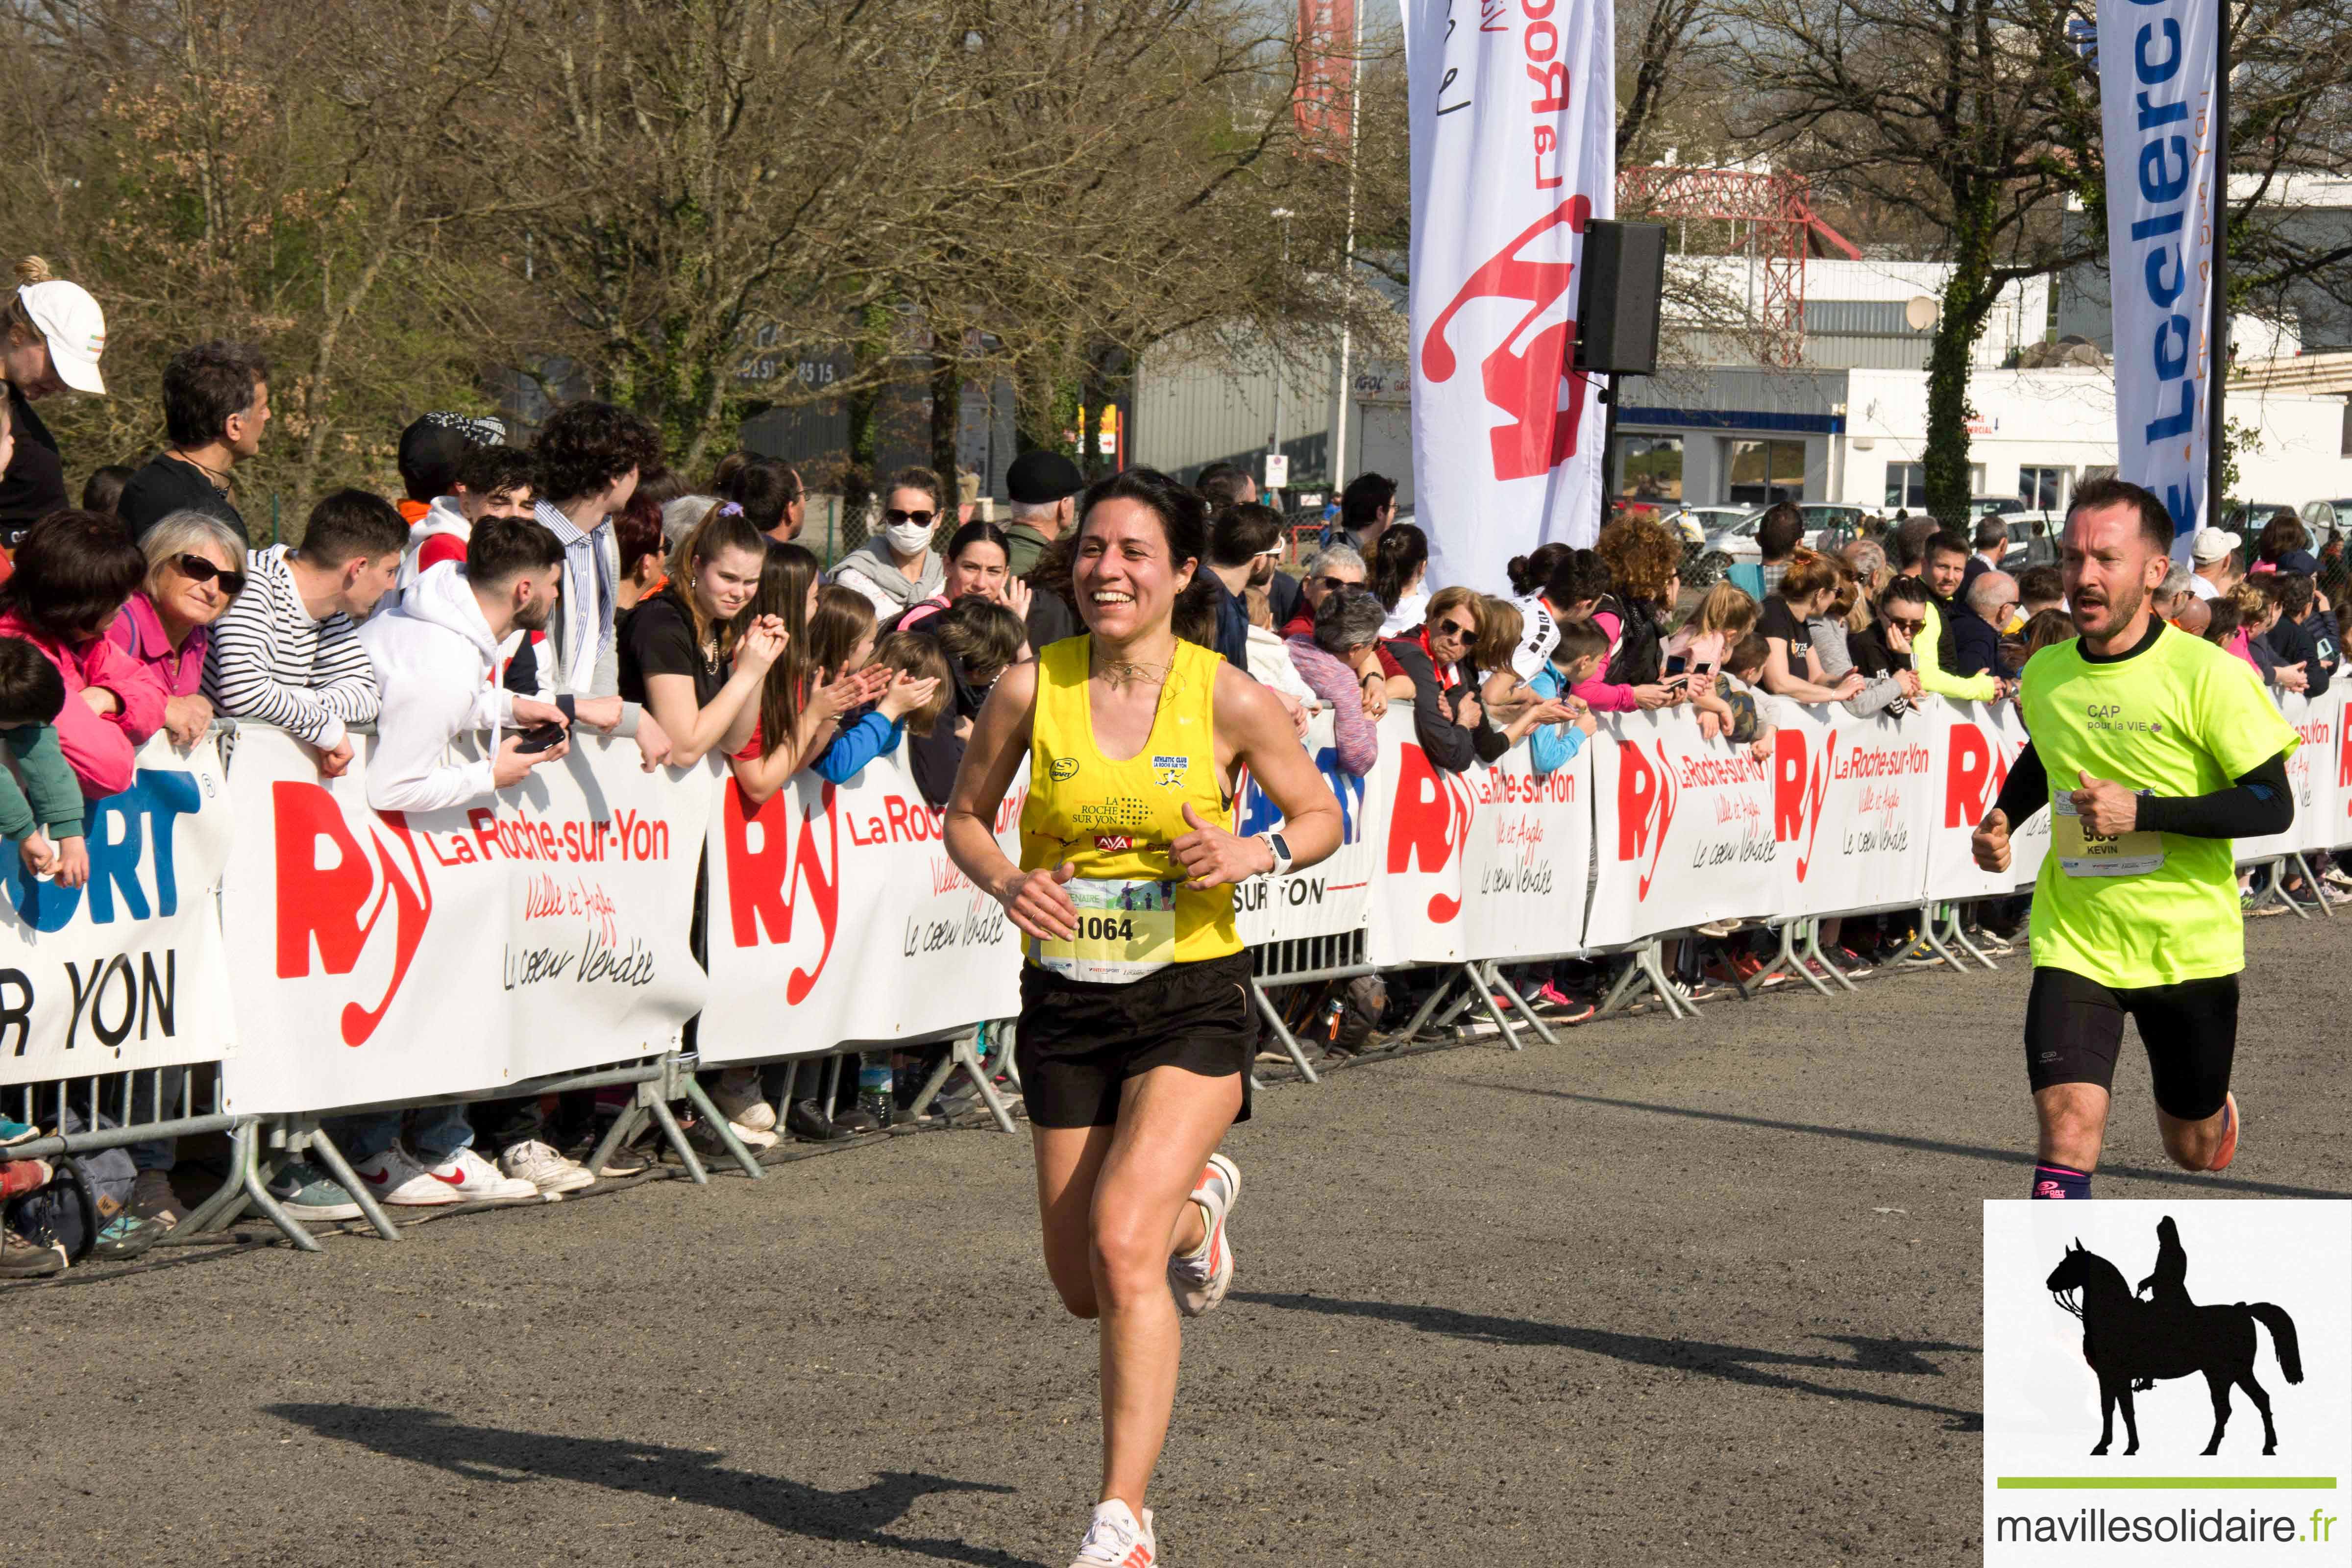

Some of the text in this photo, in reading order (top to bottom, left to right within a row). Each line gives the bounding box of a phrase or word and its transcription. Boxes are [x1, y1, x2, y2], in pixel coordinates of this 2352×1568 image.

[2087, 704, 2121, 718] CAP
[2087, 721, 2147, 732] pour la VIE
[1834, 742, 1929, 780] La Roche-sur-Yon
[1072, 814, 1092, 823] SUR
[1081, 805, 1118, 815] ROCHE
[1105, 797, 1118, 805] LA
[423, 807, 669, 866] La Roche-sur-Yon
[846, 811, 888, 847] La
[1516, 813, 1544, 867] Agglo
[1692, 839, 1707, 868] Le
[1740, 827, 1776, 863] Vendée
[1843, 827, 1854, 855] Le
[0, 768, 200, 933] ORT
[2087, 846, 2118, 855] KEVIN
[1516, 853, 1552, 895] Vendée
[525, 871, 565, 921] Ville
[1232, 881, 1267, 913] SUR
[904, 914, 920, 957] Le
[1078, 916, 1134, 941] 1064
[577, 929, 655, 986] Vendée
[0, 949, 176, 1057] R YON
